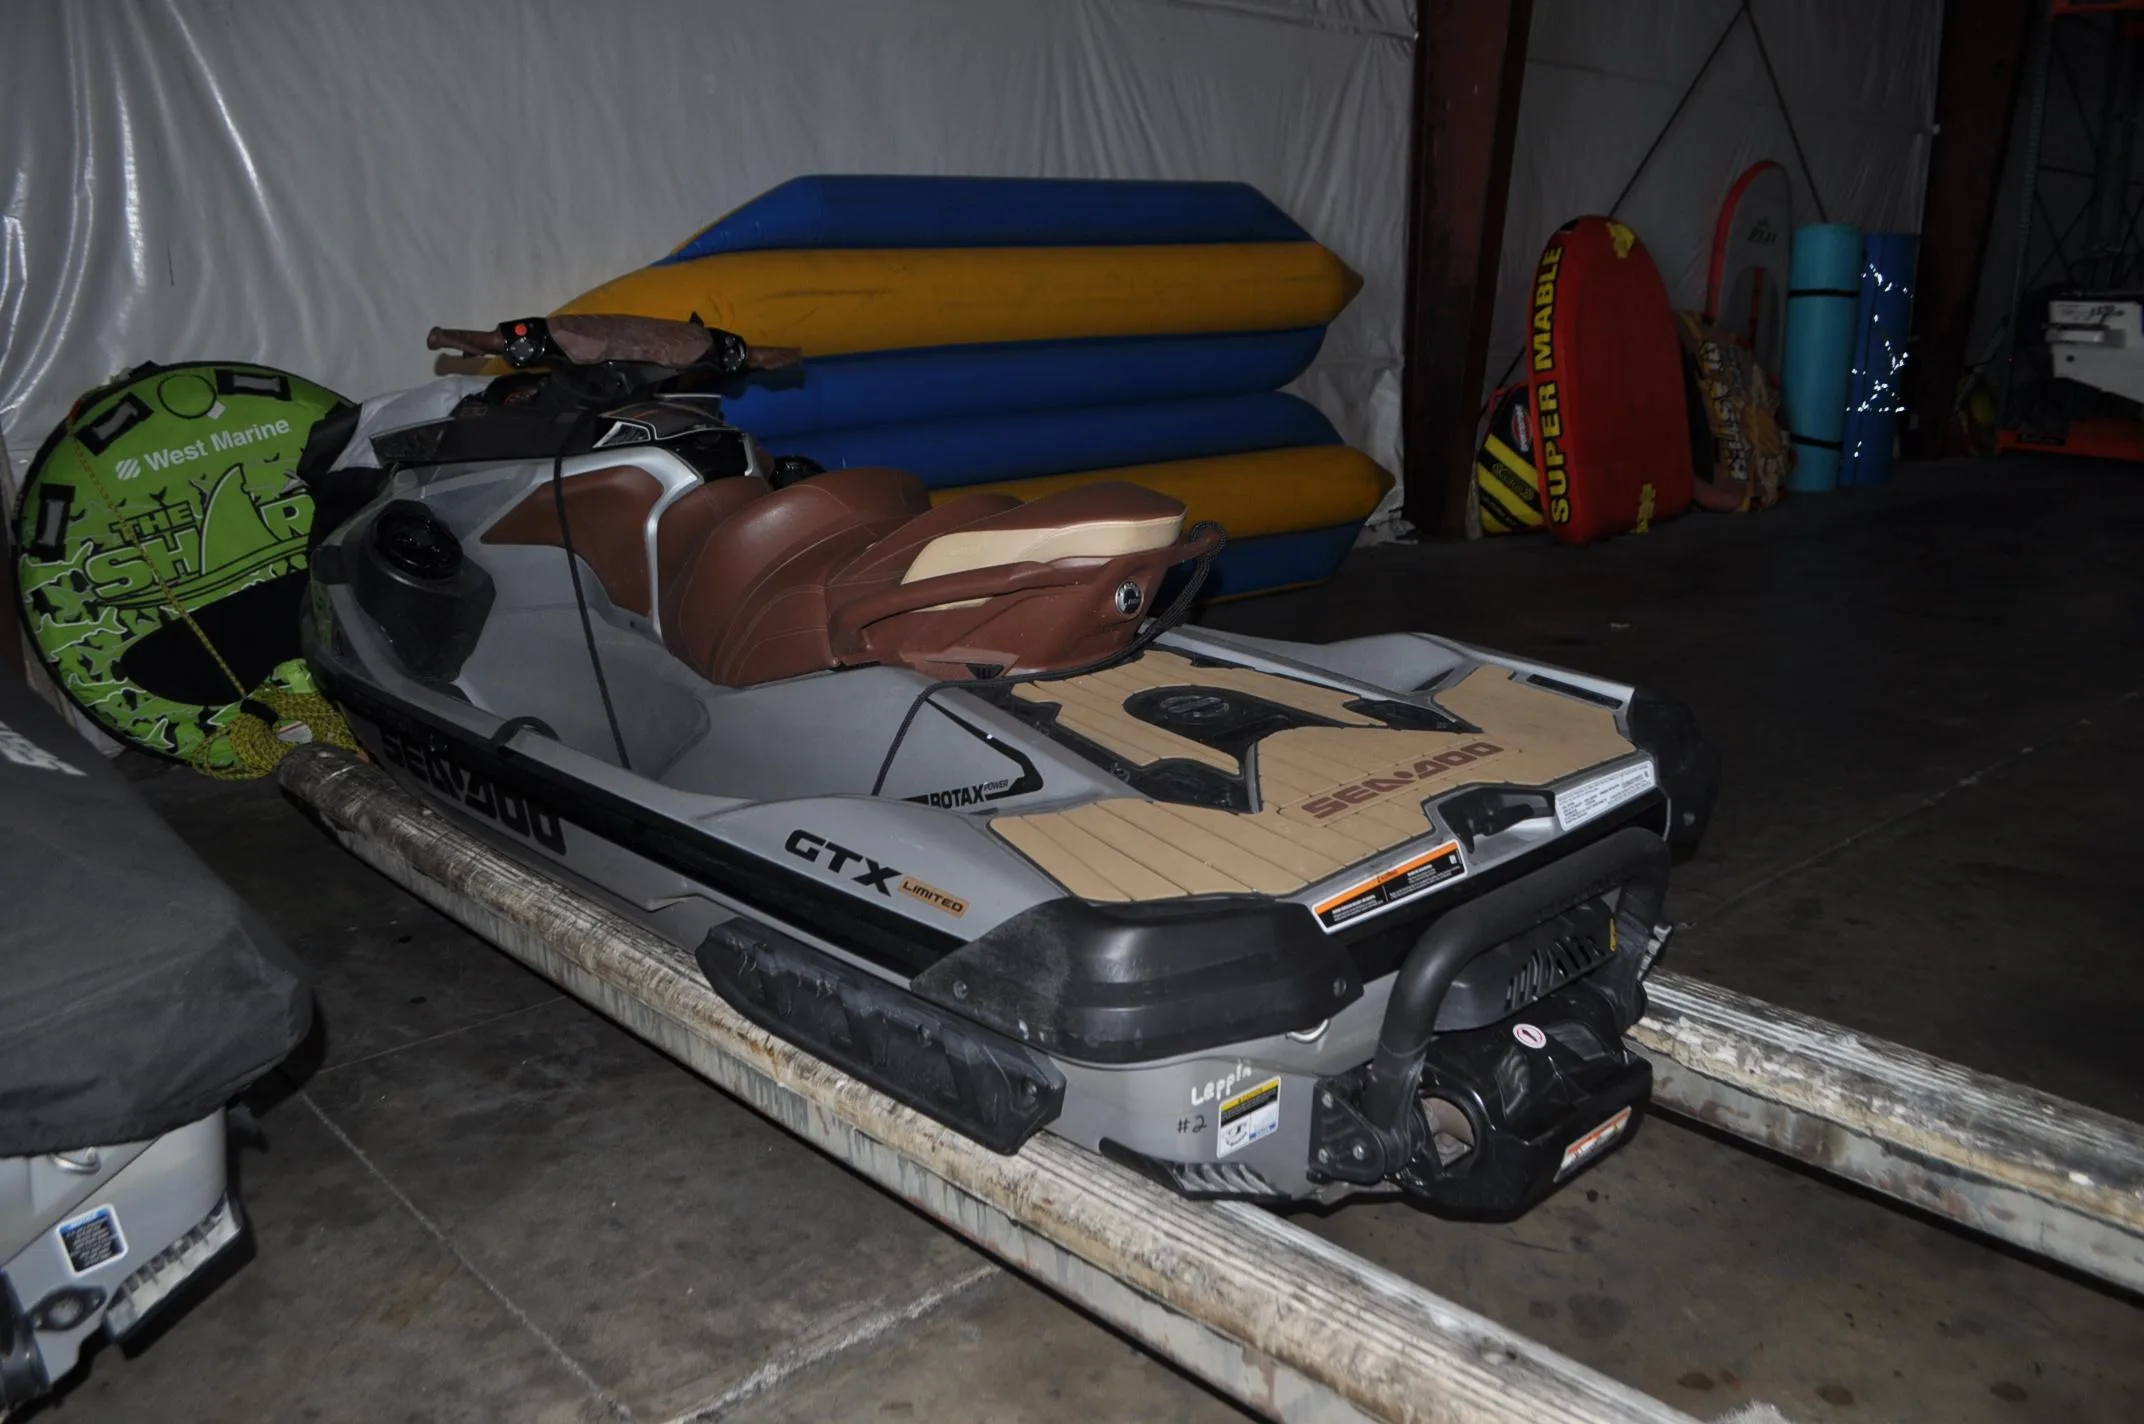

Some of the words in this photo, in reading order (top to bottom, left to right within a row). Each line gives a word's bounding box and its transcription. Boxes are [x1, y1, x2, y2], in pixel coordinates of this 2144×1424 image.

[1534, 247, 1563, 372] MABLE
[144, 440, 208, 472] West
[210, 418, 290, 452] Marine
[1538, 382, 1571, 524] SUPER
[109, 501, 199, 544] THE
[928, 784, 986, 810] ROTAX
[983, 779, 1009, 792] POWER
[784, 828, 903, 897] GTX
[902, 880, 963, 914] LIMITED
